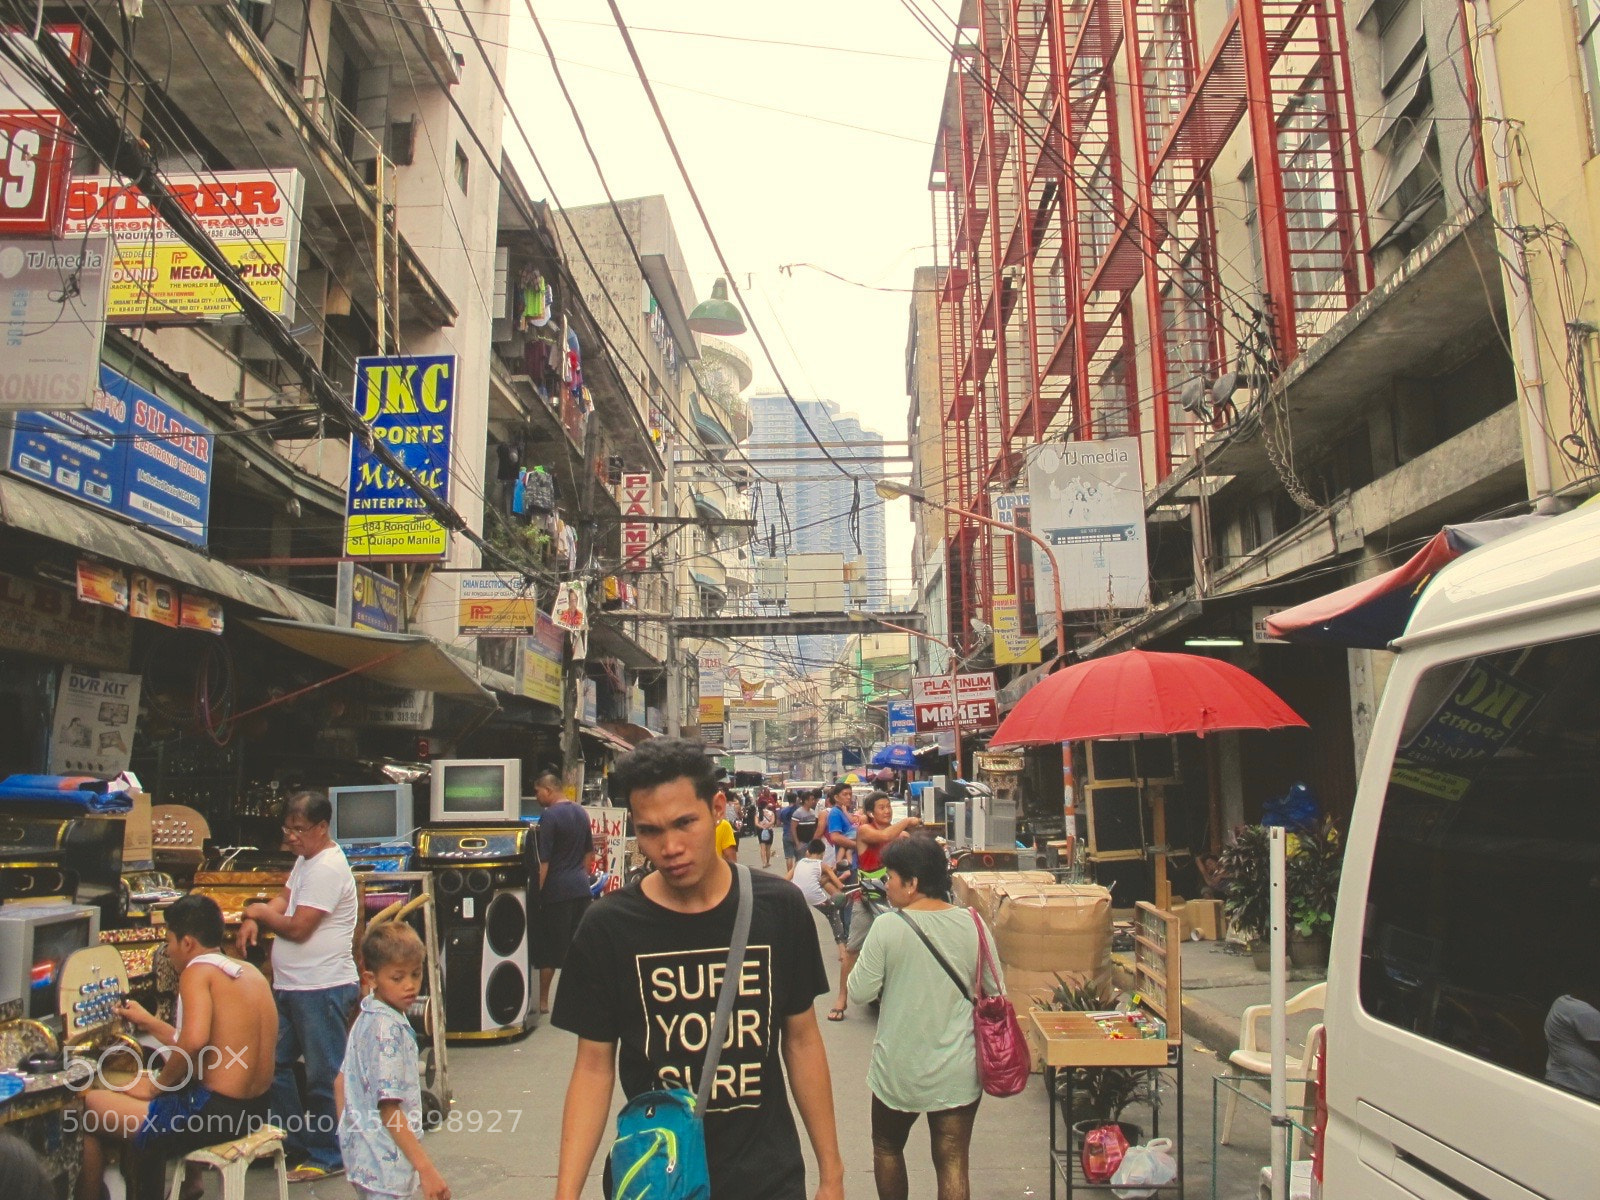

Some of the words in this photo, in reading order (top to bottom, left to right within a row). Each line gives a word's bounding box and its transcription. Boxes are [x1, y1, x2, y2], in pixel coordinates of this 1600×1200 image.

[199, 217, 284, 230] TRADING
[27, 252, 46, 267] TJ
[48, 250, 102, 268] media
[243, 263, 281, 278] PLUS
[362, 363, 450, 422] JKC
[135, 400, 208, 463] SILBER
[370, 424, 444, 444] PORTS
[133, 434, 179, 470] ELECTRONIC
[178, 456, 207, 484] TRADING
[1062, 451, 1078, 465] TJ
[1081, 449, 1128, 465] media
[356, 458, 444, 492] Muic
[353, 498, 432, 510] ENTERPRIS
[384, 521, 432, 534] Ronquillo
[352, 536, 366, 546] St.
[368, 536, 404, 548] Quiapo
[407, 536, 440, 546] Manila
[68, 676, 99, 693] DVR
[103, 680, 129, 696] KIT
[924, 676, 991, 690] PLAINUM
[937, 718, 977, 727] ELECTONICS
